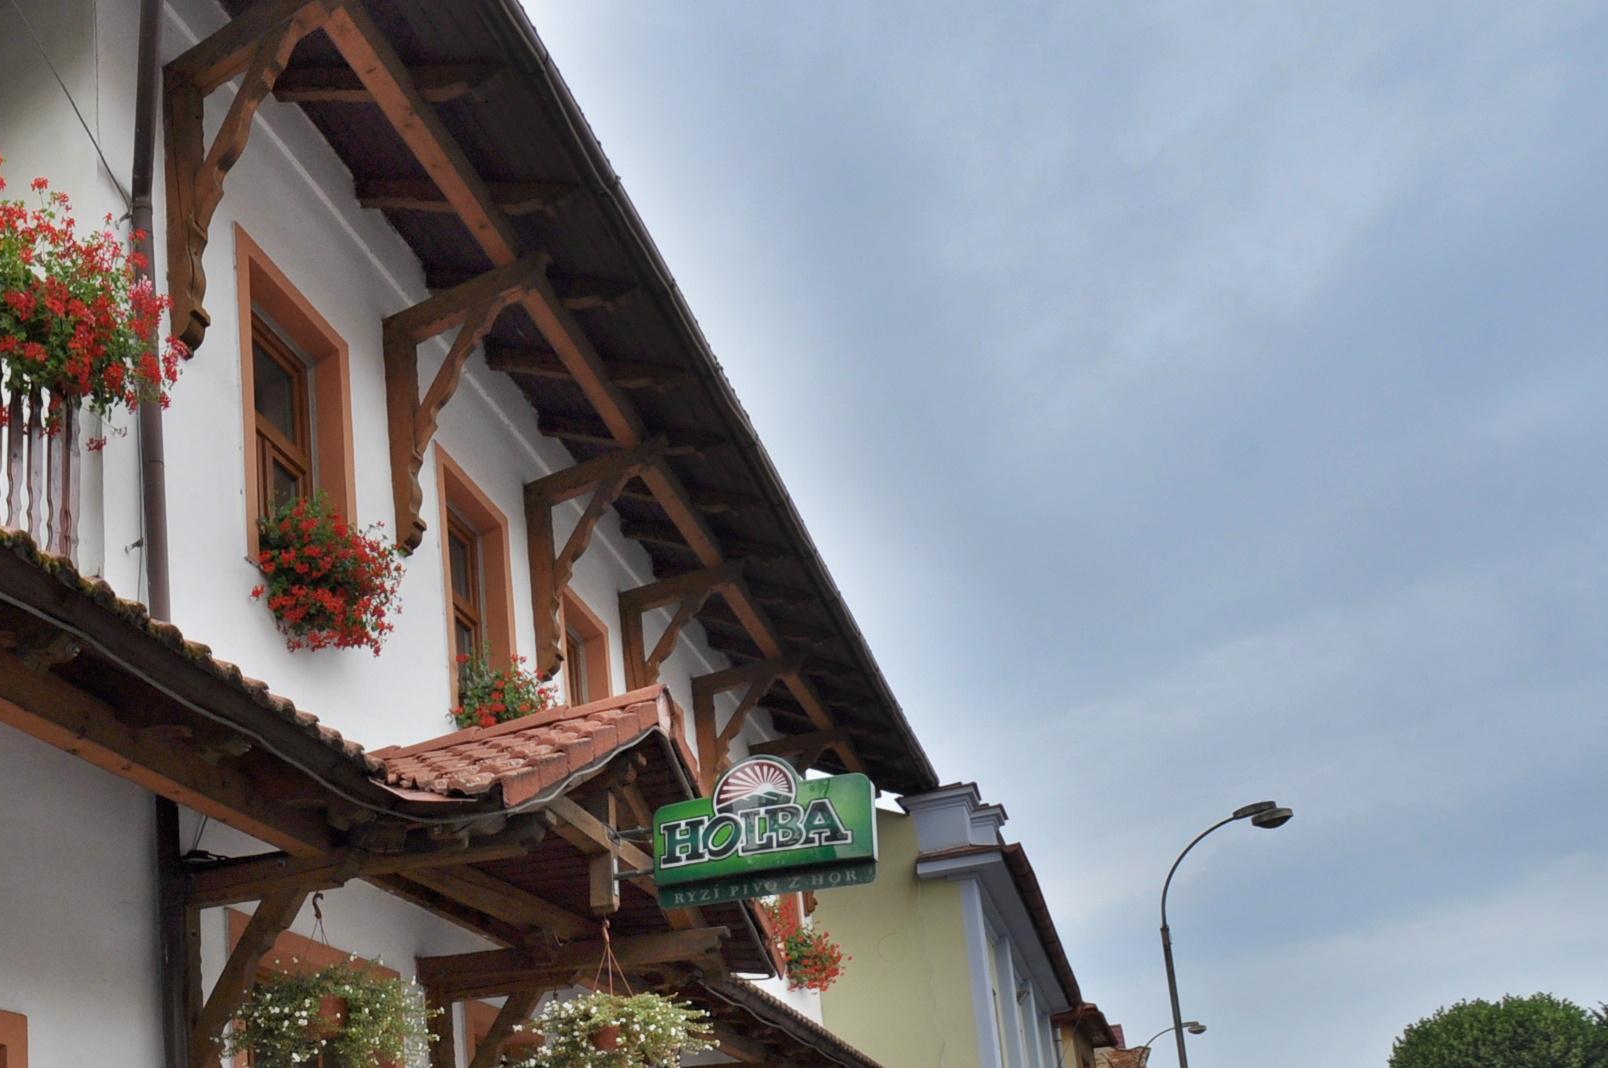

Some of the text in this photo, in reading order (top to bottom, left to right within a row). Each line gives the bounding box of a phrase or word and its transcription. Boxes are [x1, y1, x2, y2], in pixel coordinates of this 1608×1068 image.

[660, 798, 853, 869] HOLBA
[674, 869, 858, 904] RYZÍ PIVO Z HOR
